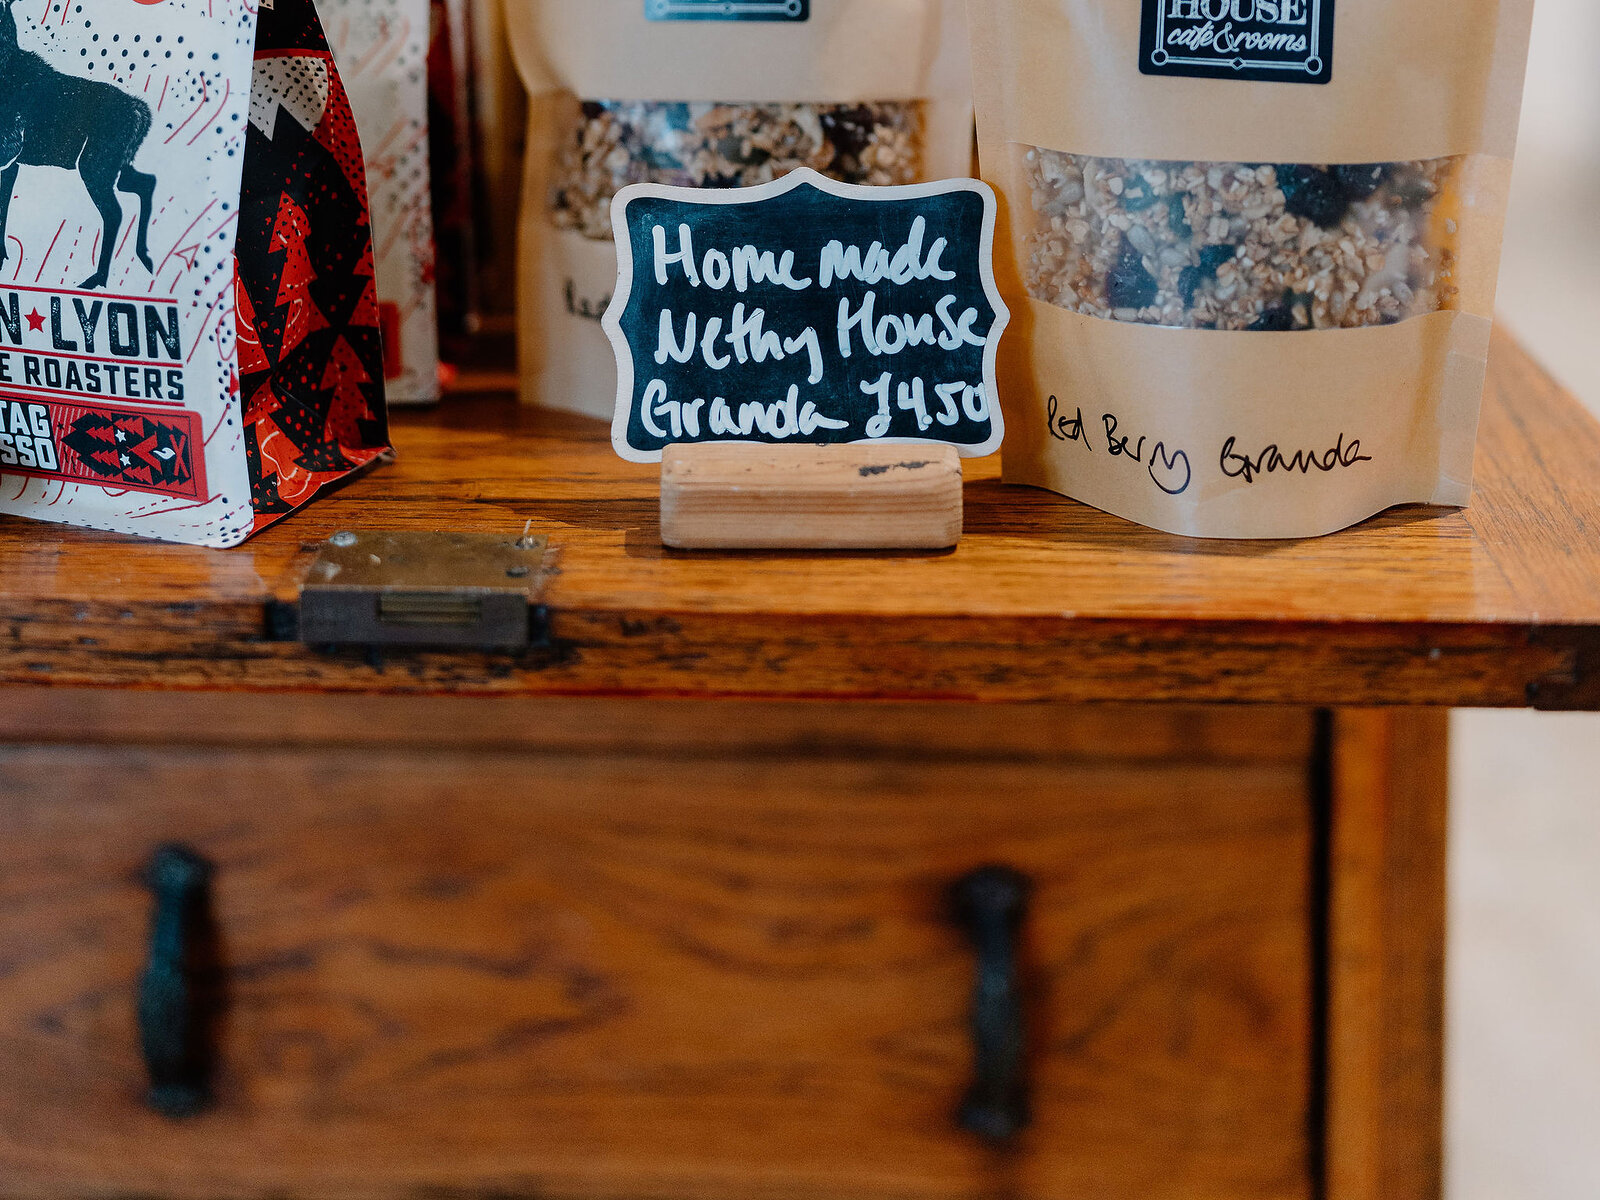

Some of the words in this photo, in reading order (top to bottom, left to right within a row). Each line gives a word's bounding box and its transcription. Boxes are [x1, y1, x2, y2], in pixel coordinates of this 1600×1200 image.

[50, 296, 181, 360] LYON
[654, 302, 823, 384] Nethy
[837, 291, 986, 358] House
[24, 355, 184, 401] ROASTERS
[1048, 395, 1092, 452] Red
